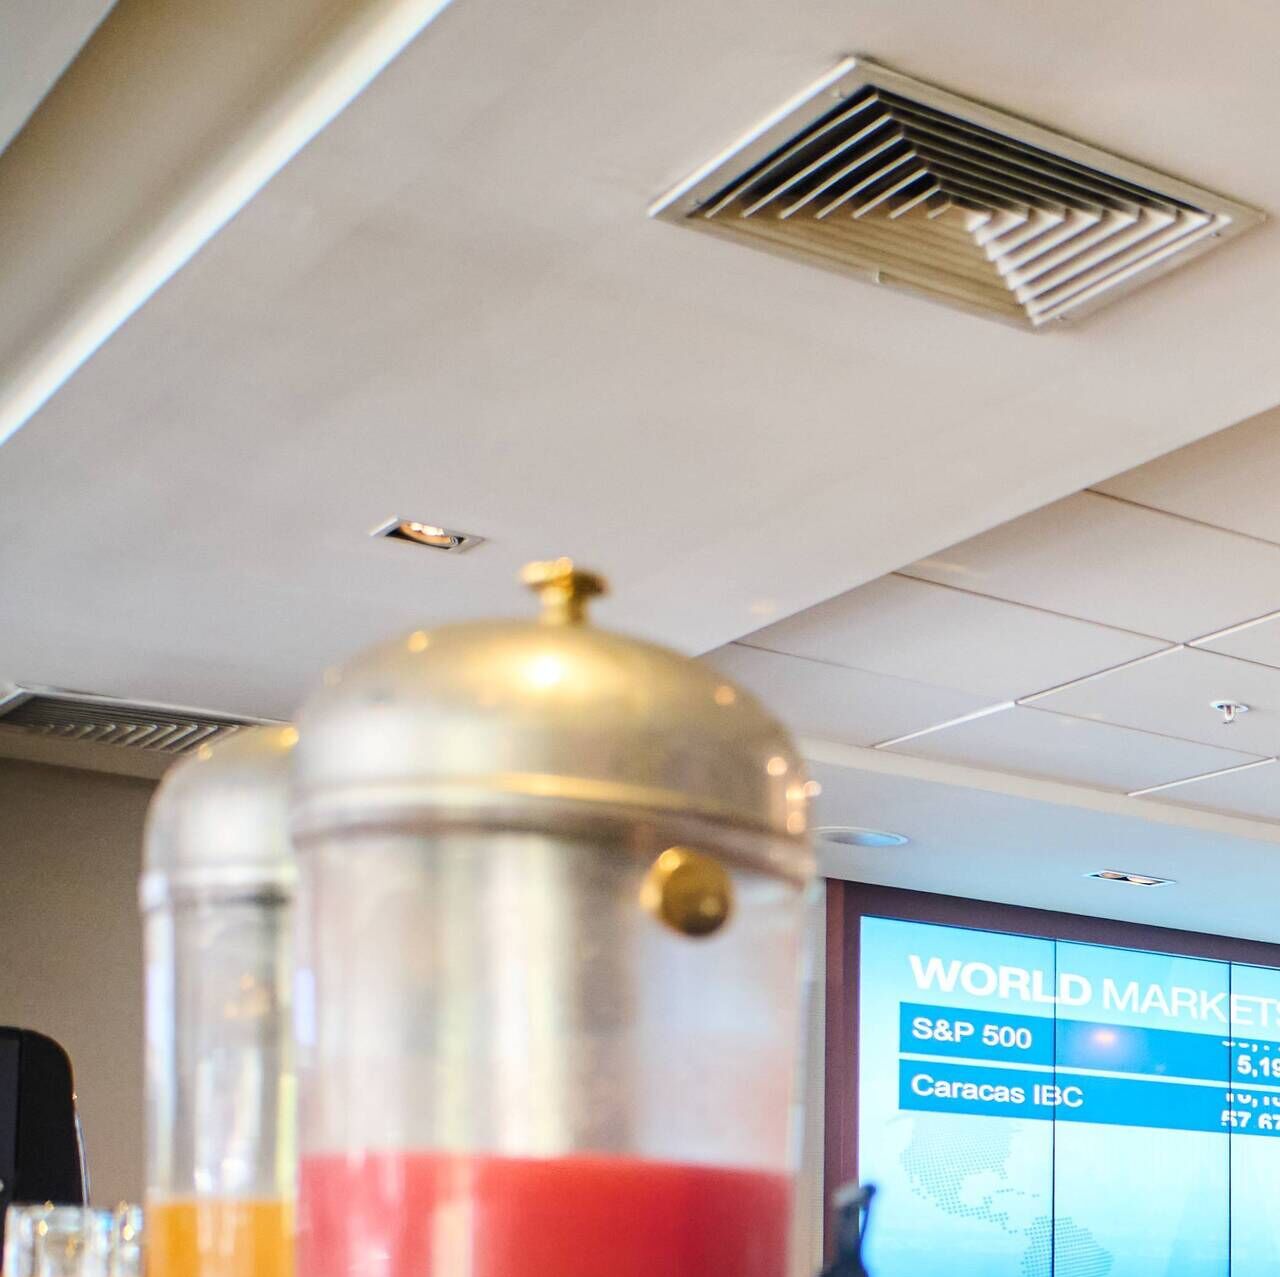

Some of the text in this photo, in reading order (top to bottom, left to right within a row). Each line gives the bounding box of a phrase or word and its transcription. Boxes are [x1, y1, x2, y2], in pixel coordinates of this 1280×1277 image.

[909, 954, 1092, 1007] WORLD
[911, 1016, 1033, 1050] S&P 500
[911, 1073, 1085, 1108] Caracas IBC
